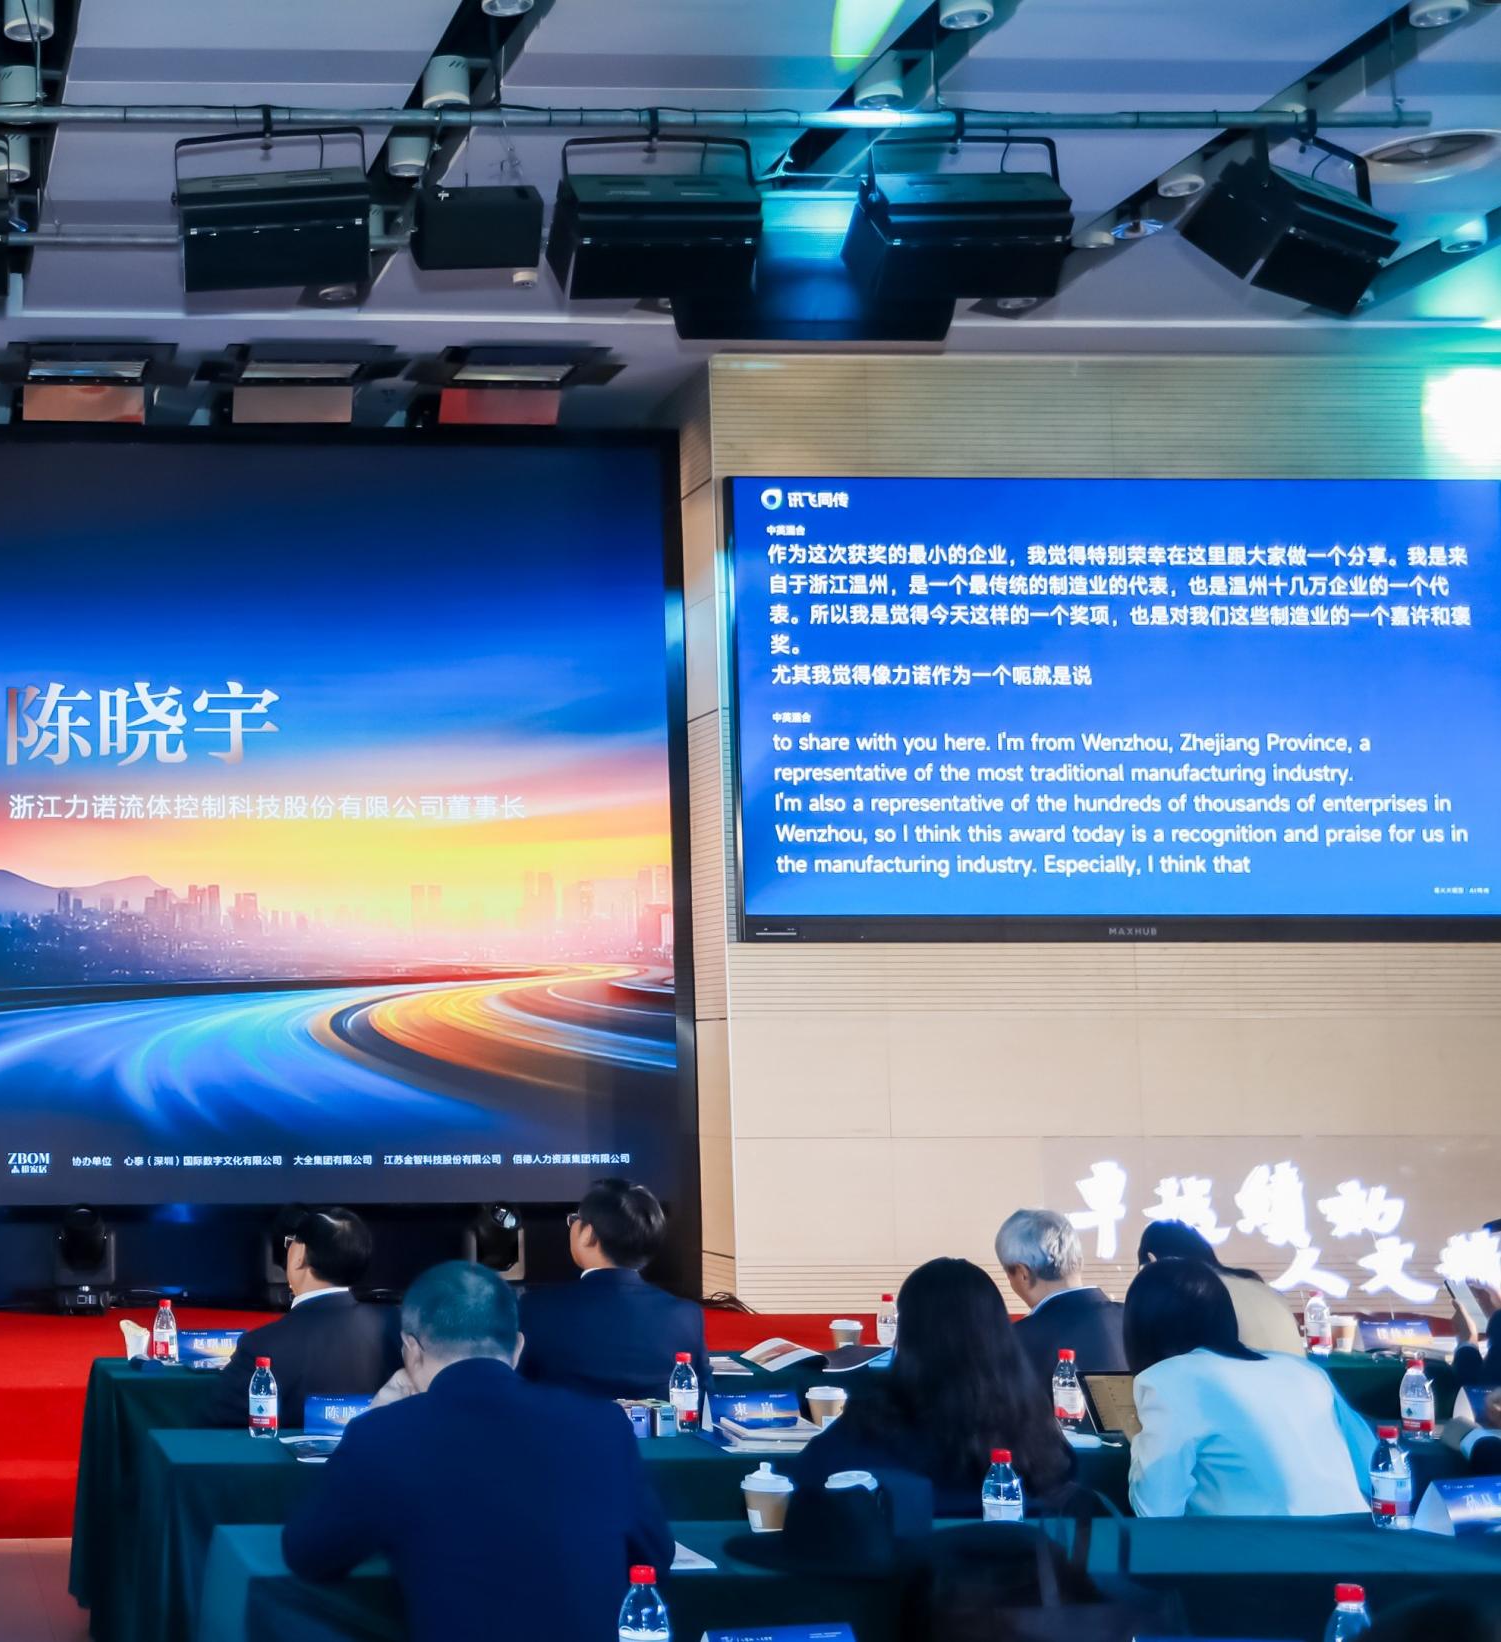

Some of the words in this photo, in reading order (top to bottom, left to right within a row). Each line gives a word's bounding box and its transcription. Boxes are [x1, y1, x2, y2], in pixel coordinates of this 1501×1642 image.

[770, 632, 801, 656] 奖。
[5, 681, 280, 766] 陈晓宇
[772, 733, 793, 751] to
[798, 732, 851, 751] share
[855, 732, 898, 752] with
[902, 736, 938, 756] you
[943, 732, 991, 752] here.
[997, 731, 1025, 751] I'm
[1030, 732, 1076, 752] from
[1081, 732, 1174, 754] Wenzhou,
[1179, 732, 1260, 757] Zhejiang
[1266, 732, 1353, 754] Province,
[1359, 737, 1371, 752] a
[773, 762, 908, 786] representative
[913, 762, 934, 782] of
[939, 763, 971, 782] the
[977, 764, 1024, 782] most
[1029, 763, 1125, 782] traditional
[1130, 763, 1267, 787] manufacturing
[1272, 763, 1353, 786] industry.
[8, 793, 526, 821] 浙江力诺流体控制科技股份有限公司董事长
[774, 791, 803, 812] I'm
[808, 793, 847, 812] also
[852, 797, 865, 813] a
[870, 793, 1005, 817] representative
[1010, 793, 1030, 813] of
[1035, 793, 1068, 813] the
[1073, 794, 1162, 813] hundreds
[1167, 793, 1188, 813] of
[1192, 793, 1291, 813] thousands
[1296, 793, 1316, 813] of
[1322, 793, 1428, 817] enterprises
[1434, 793, 1452, 812] in
[774, 823, 868, 845] Wenzhou,
[874, 828, 897, 843] so
[914, 824, 962, 843] think
[967, 824, 1003, 843] this
[1008, 824, 1066, 843] award
[1071, 824, 1126, 848] today
[1131, 824, 1147, 843] is
[1153, 828, 1165, 843] a
[1171, 824, 1277, 848] recognition
[1283, 824, 1320, 843] and
[1325, 824, 1383, 848] praise
[1387, 823, 1416, 843] for
[1421, 828, 1445, 843] us
[1450, 823, 1469, 843] in
[775, 854, 808, 874] the
[814, 854, 951, 879] manufacturing
[956, 854, 1037, 878] industry.
[1043, 854, 1141, 878] Especially,
[1158, 854, 1207, 874] think
[1212, 854, 1251, 874] that
[1108, 927, 1157, 937] MAXHUB
[7, 1152, 50, 1165] ZBOM
[71, 1155, 113, 1167] 协办单位
[293, 1154, 373, 1166] 大全集团有限公司
[383, 1153, 502, 1166] 江苏金智科技股份有限公司
